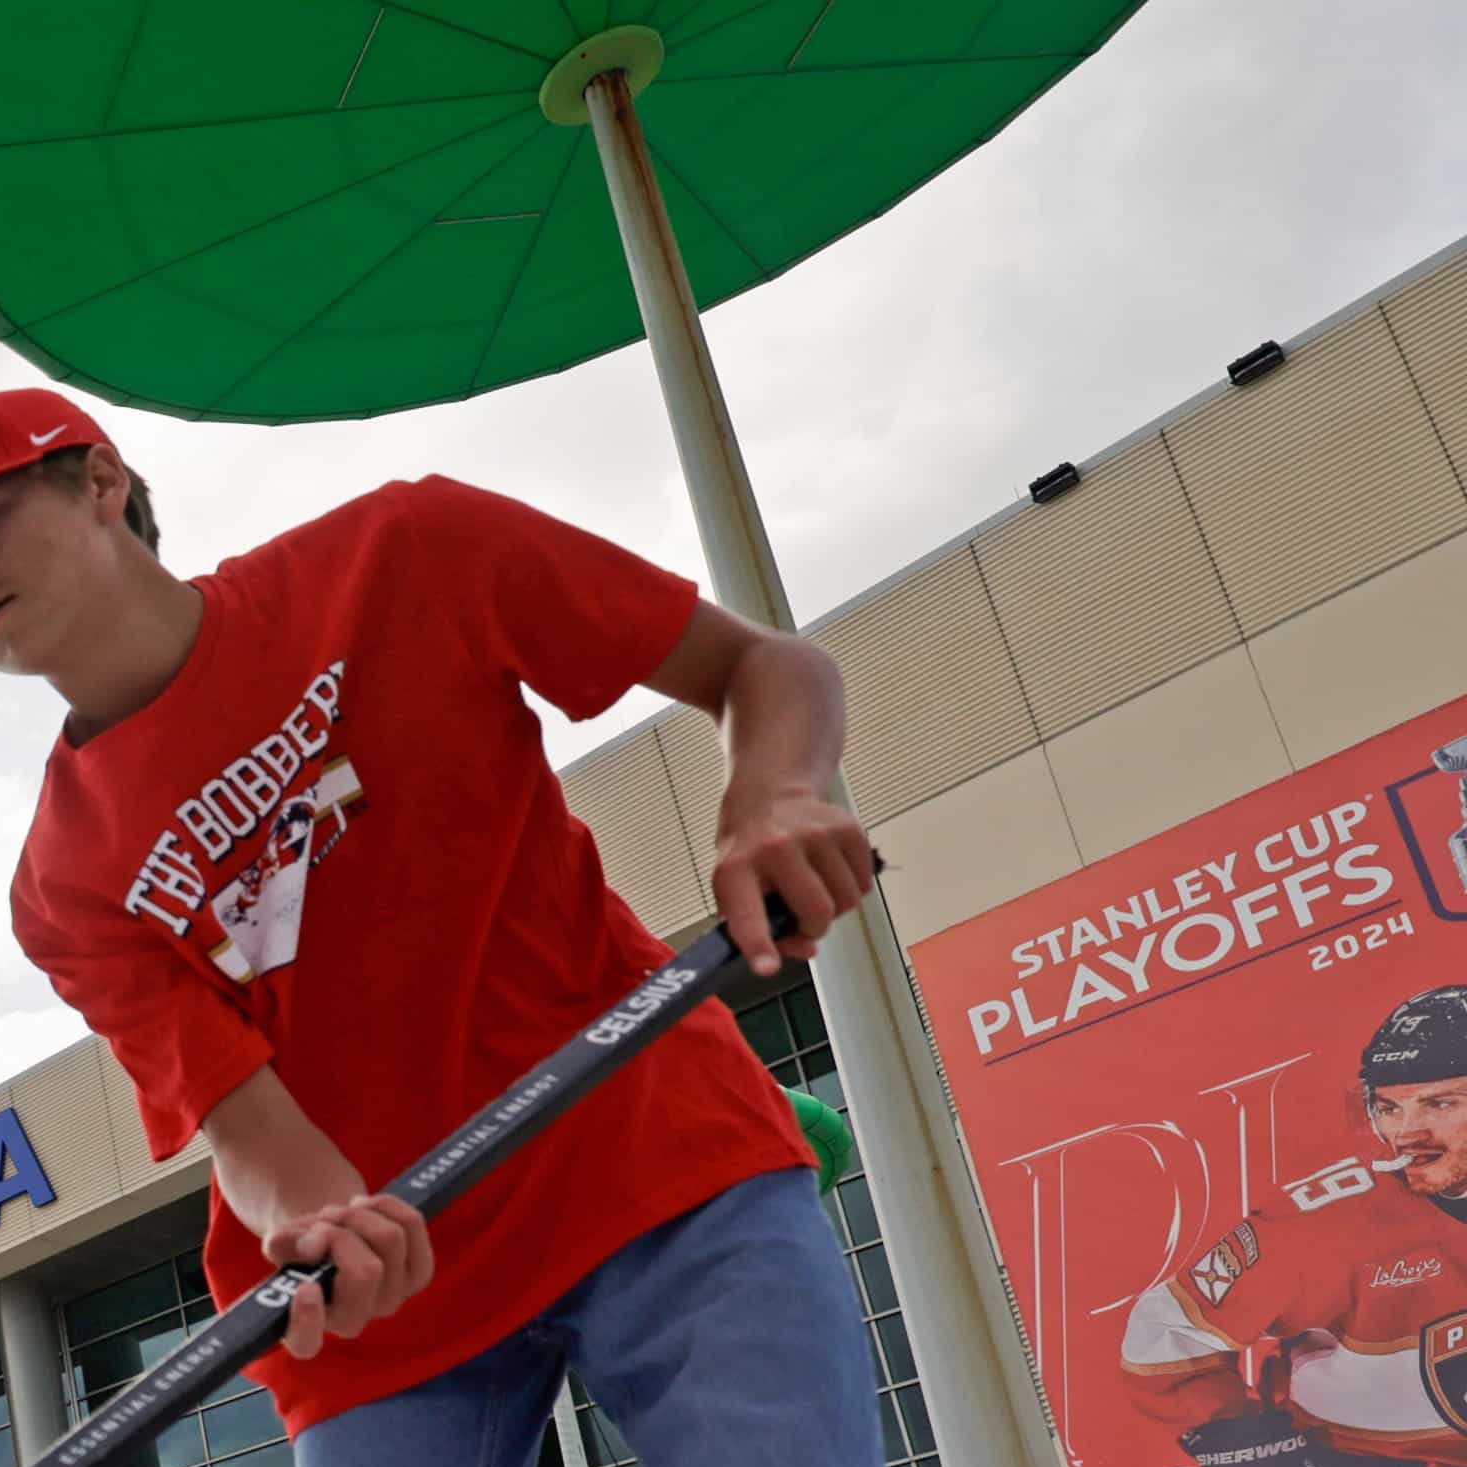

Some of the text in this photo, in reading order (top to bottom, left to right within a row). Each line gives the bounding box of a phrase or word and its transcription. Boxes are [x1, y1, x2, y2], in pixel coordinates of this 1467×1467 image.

[125, 829, 205, 936] THE
[1010, 800, 1367, 980] STANLEY CUP
[967, 843, 1393, 1056] PLAYOFFS
[1308, 911, 1415, 971] 2024
[585, 967, 697, 1045] CELSIUS
[1371, 1049, 1420, 1063] CCM
